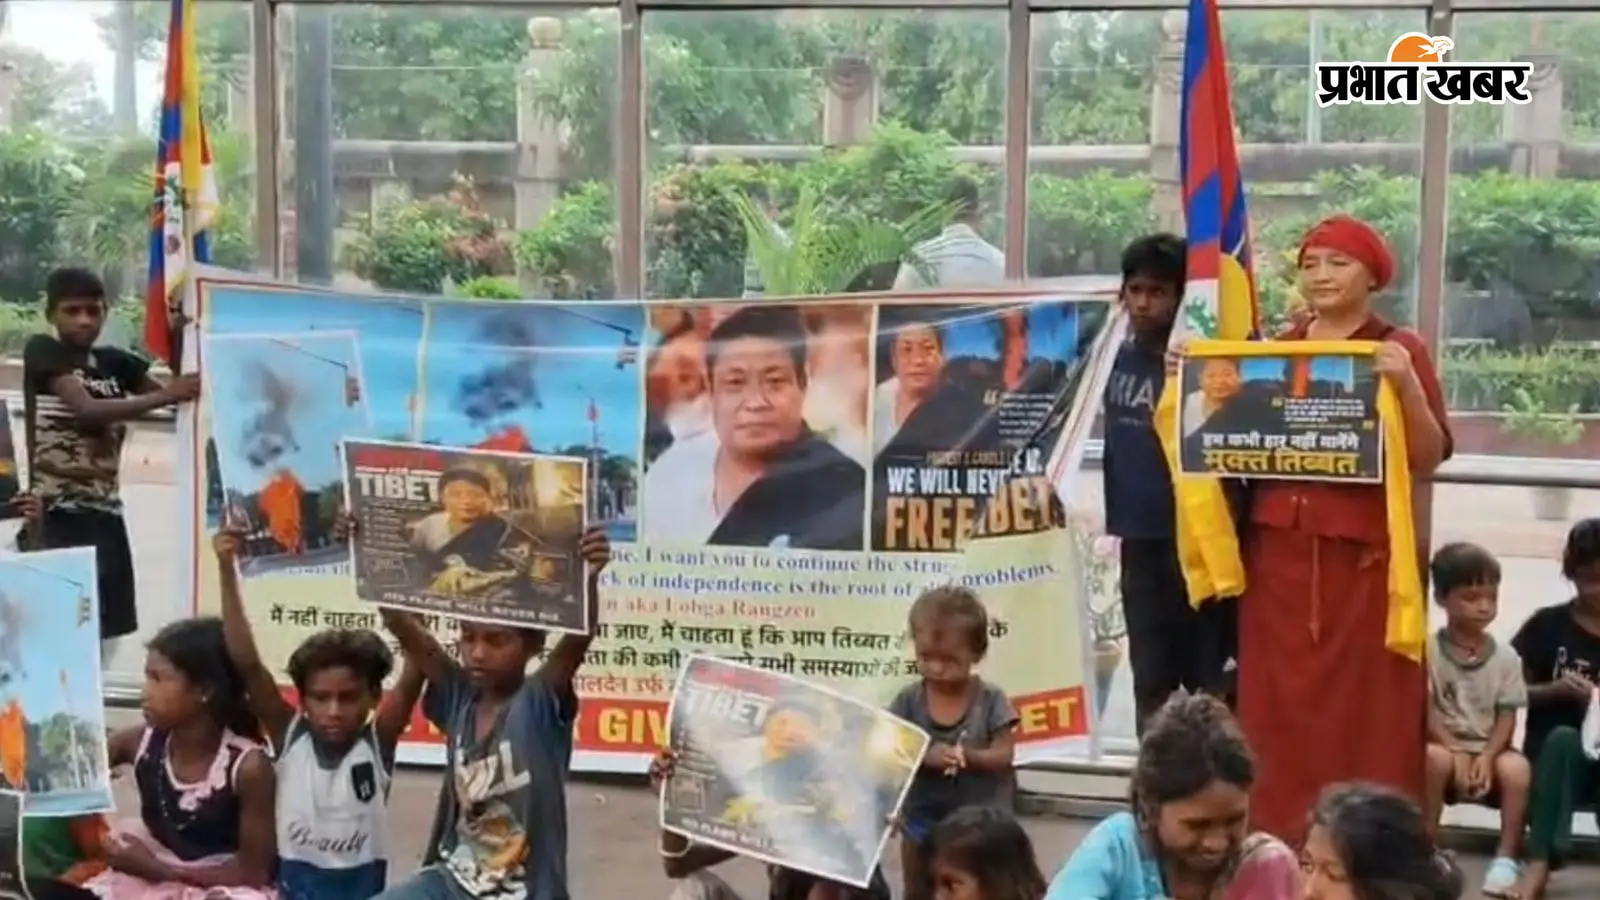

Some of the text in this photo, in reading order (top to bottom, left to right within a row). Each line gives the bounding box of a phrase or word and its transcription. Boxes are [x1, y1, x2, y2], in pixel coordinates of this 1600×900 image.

[1274, 447, 1360, 474] तिब्बत
[887, 467, 1006, 494] WE WILL NEV
[886, 496, 975, 549] FREE
[659, 551, 704, 566] want
[712, 553, 746, 569] you
[753, 552, 770, 568] to
[777, 555, 860, 571] continue
[867, 555, 896, 572] the
[628, 572, 646, 588] of
[653, 572, 784, 594] independence
[789, 580, 804, 594] is
[811, 579, 842, 595] the
[848, 582, 887, 597] root
[894, 581, 912, 597] of
[288, 606, 320, 627] नहीं
[324, 611, 376, 630] चाहता
[733, 600, 816, 619] Rangzen
[680, 625, 734, 645] चाहता
[760, 624, 784, 646] कि
[791, 629, 826, 648] आप
[832, 625, 891, 650] तिब्बत
[613, 645, 638, 667] की
[643, 649, 681, 669] कमी
[600, 707, 670, 746] GIV
